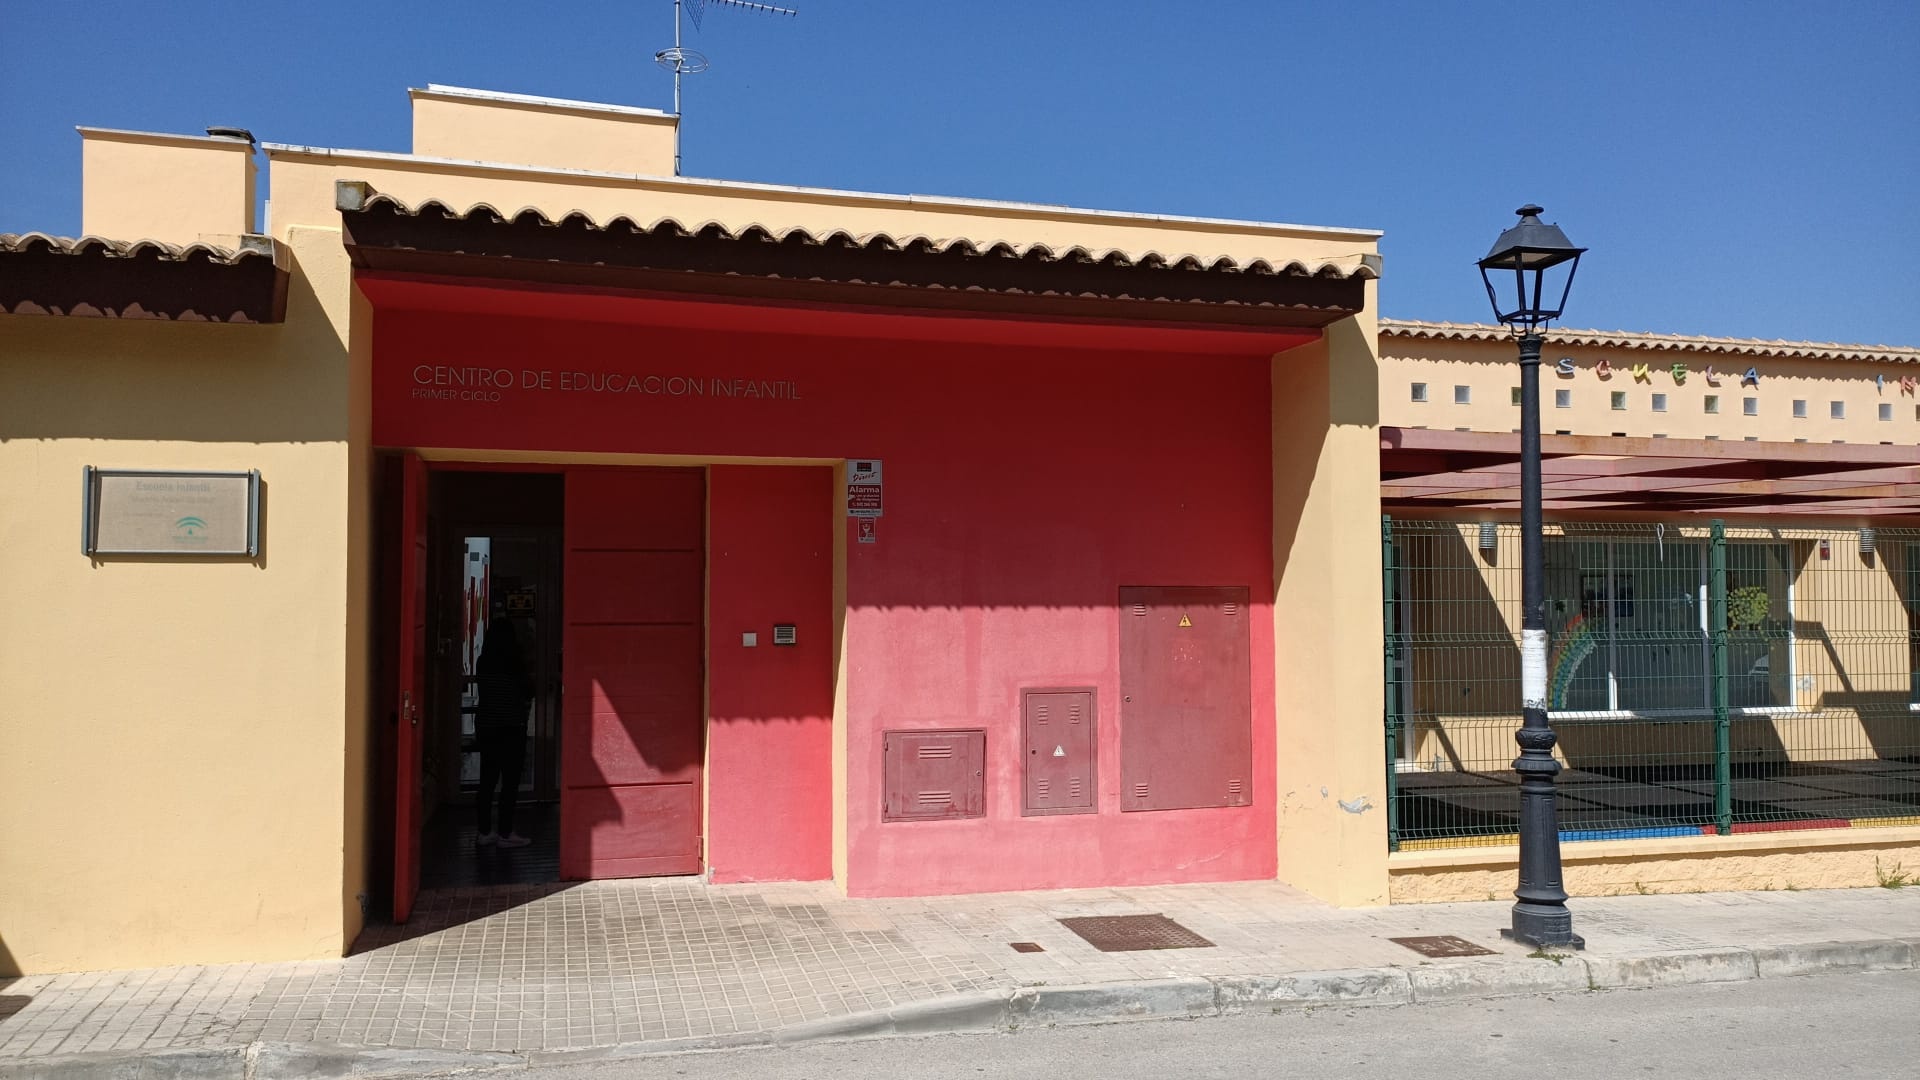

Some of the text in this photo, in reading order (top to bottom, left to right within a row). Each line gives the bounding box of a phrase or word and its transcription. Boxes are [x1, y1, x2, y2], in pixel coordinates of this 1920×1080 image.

[413, 365, 801, 400] CENTRO DE EDUCACION INFANTIL
[1555, 358, 1761, 387] SCUELA
[412, 388, 501, 402] PRIMER CICLO
